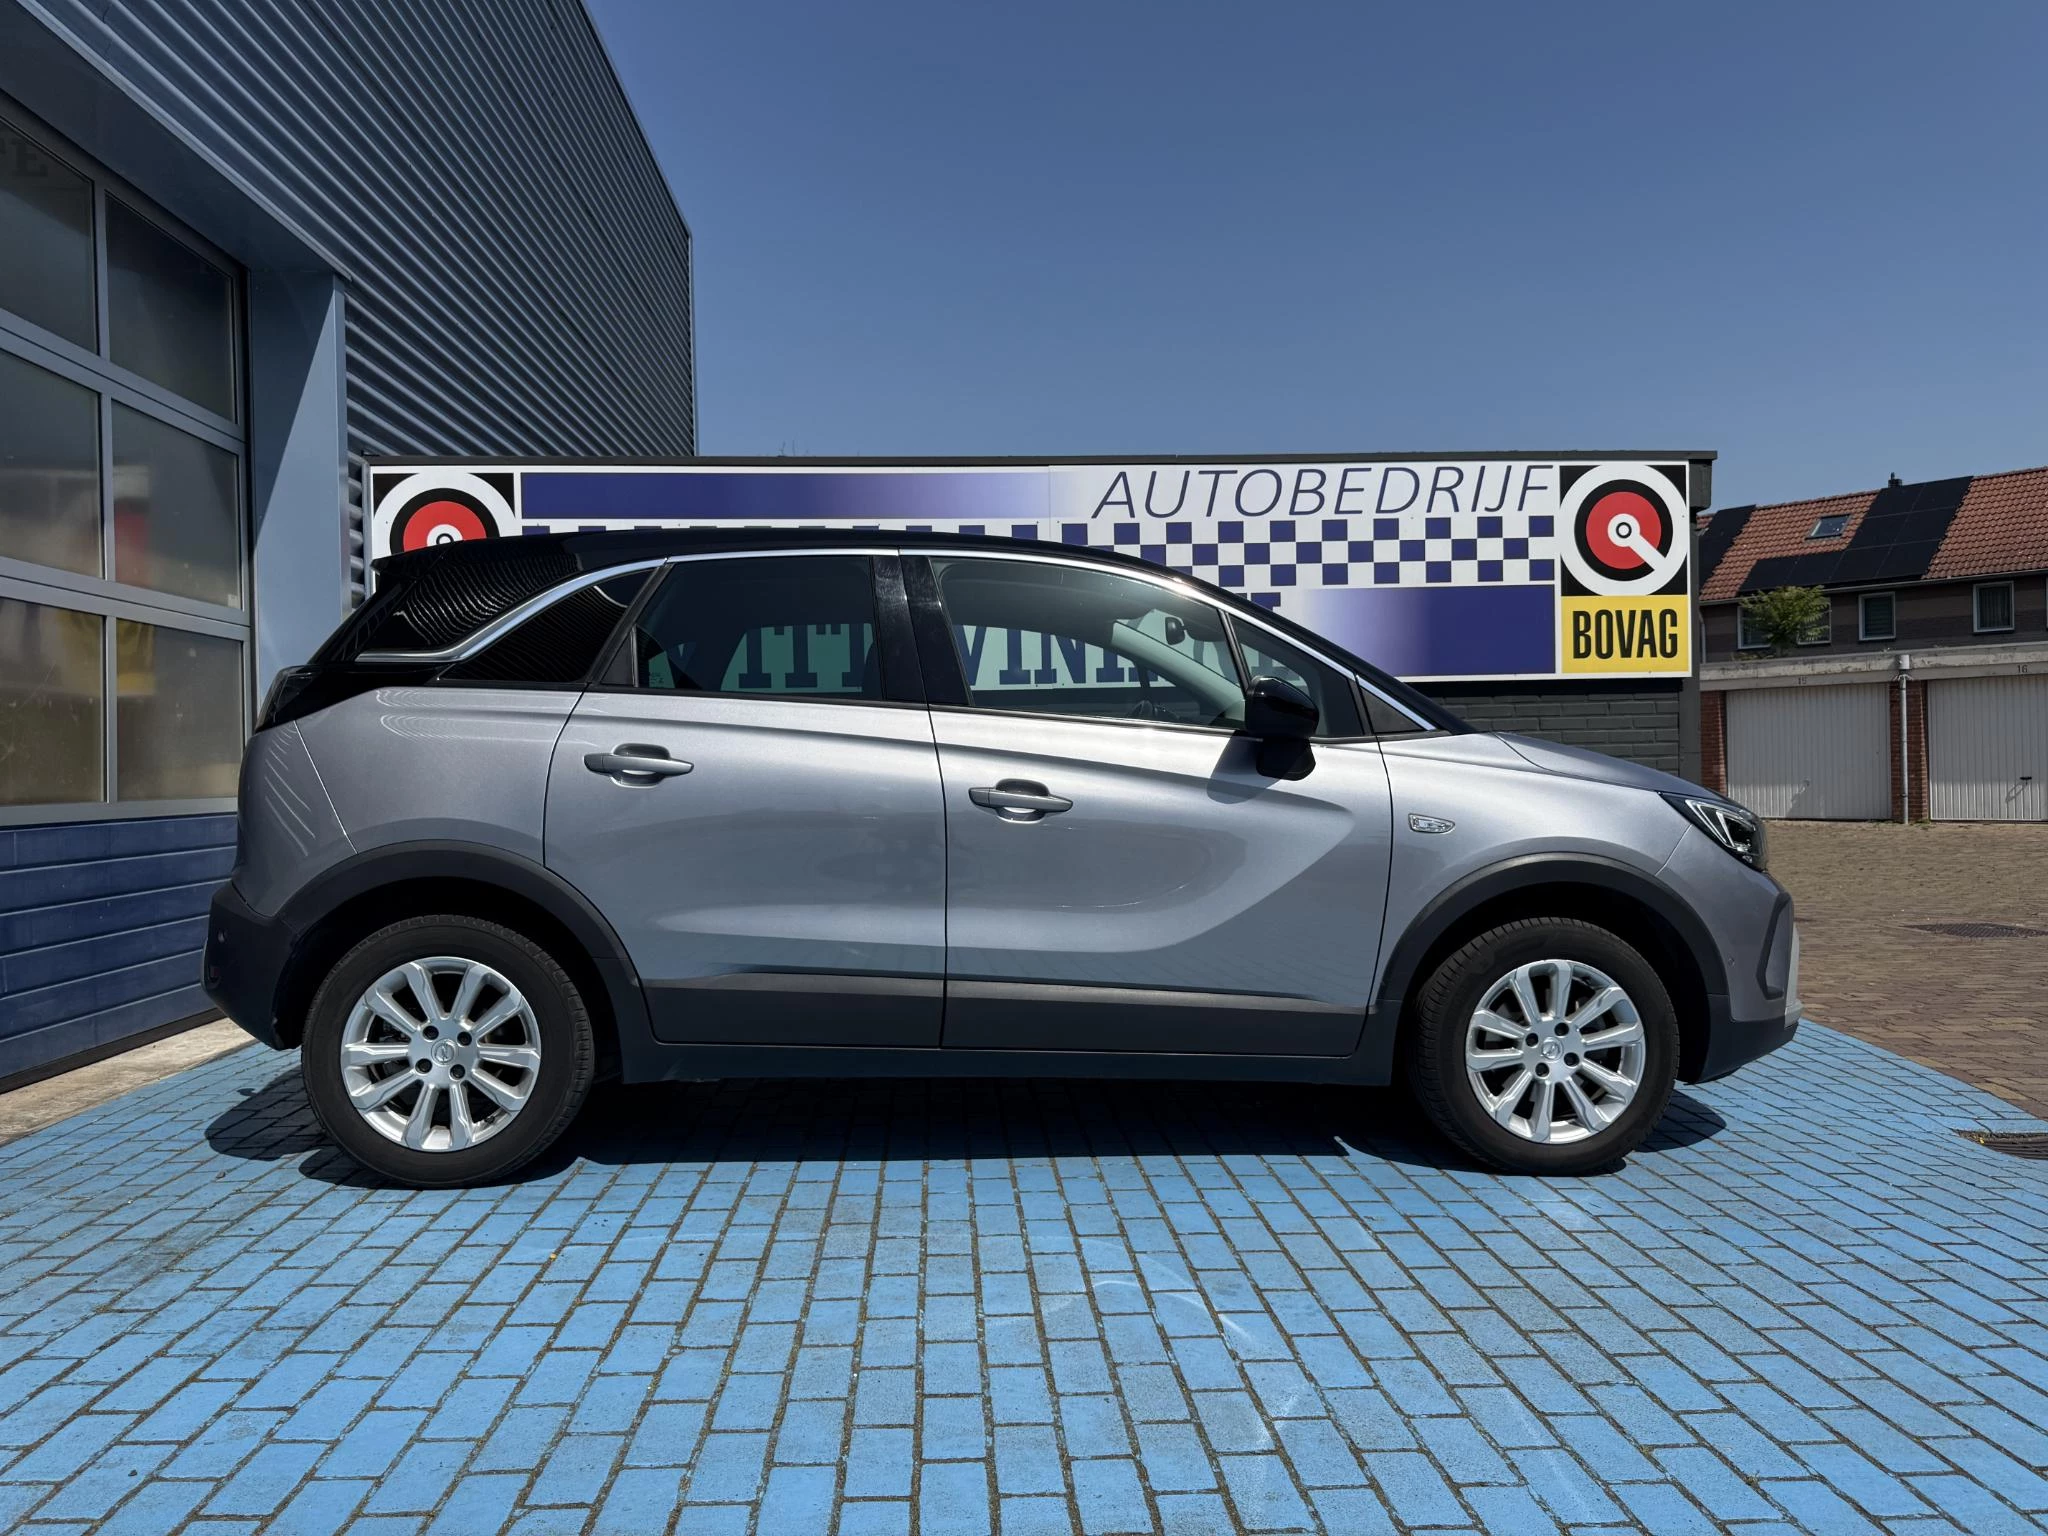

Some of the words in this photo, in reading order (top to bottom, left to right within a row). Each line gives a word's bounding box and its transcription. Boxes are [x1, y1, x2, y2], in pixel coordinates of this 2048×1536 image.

[1091, 464, 1554, 519] AUTOBEDRIJF
[1572, 608, 1678, 660] BOVAG
[2017, 664, 2028, 673] 16
